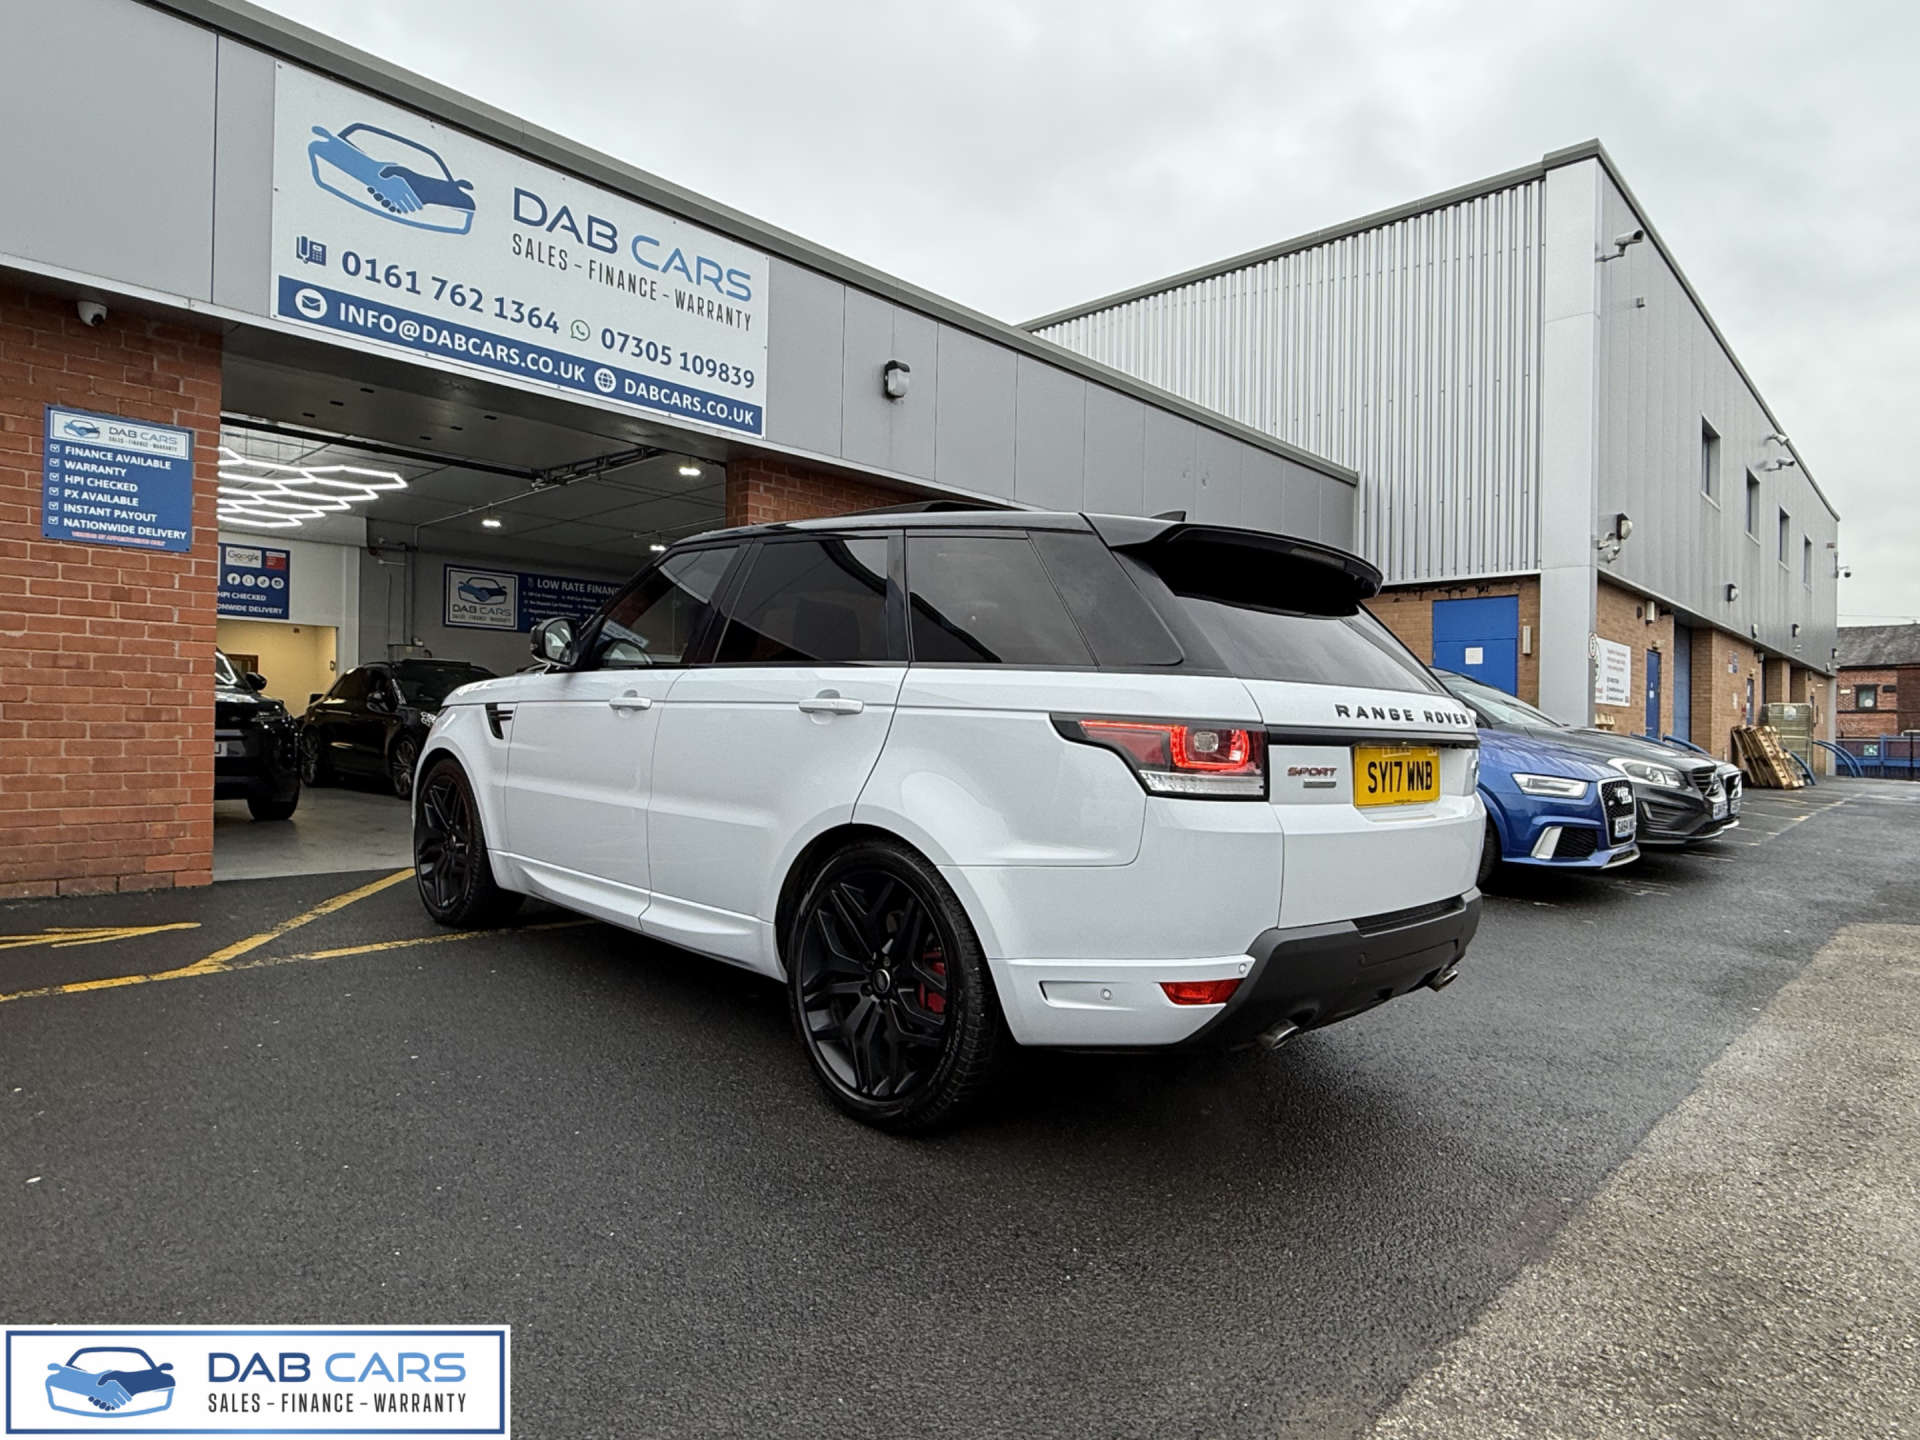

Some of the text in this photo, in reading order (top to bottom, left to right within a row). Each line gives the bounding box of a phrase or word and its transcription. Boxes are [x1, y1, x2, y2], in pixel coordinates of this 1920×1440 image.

[513, 187, 752, 301] DAB CARS
[342, 251, 559, 334] 0161 762 1364
[512, 233, 568, 271] SALES
[588, 259, 657, 301] FINANCE
[674, 288, 752, 332] WARRANTY
[339, 303, 585, 383] INFO@DABCARS.CO.UK
[601, 328, 755, 389] 07305 109839
[624, 378, 754, 426] DABCARS.CO.UK
[109, 426, 178, 445] DAB CARS
[64, 445, 172, 471] FINANCE AVAILABLE
[64, 460, 127, 477] WARRANTY
[64, 474, 138, 493] HPI CHECKED
[64, 488, 139, 507] PX AVAILABLE
[64, 503, 157, 523] INSTANT PAYOUT
[63, 518, 135, 534] NATIONWIDE
[138, 526, 187, 540] DELIVERY
[537, 578, 560, 590] LOW
[561, 581, 585, 593] RATE
[231, 592, 267, 601] CHECKED
[248, 605, 283, 614] DELIVERY
[452, 603, 512, 617] DAB CARS
[1334, 703, 1469, 725] RANGE ROVER
[1287, 766, 1338, 777] SPORT
[1367, 760, 1433, 794] SY17 WNB
